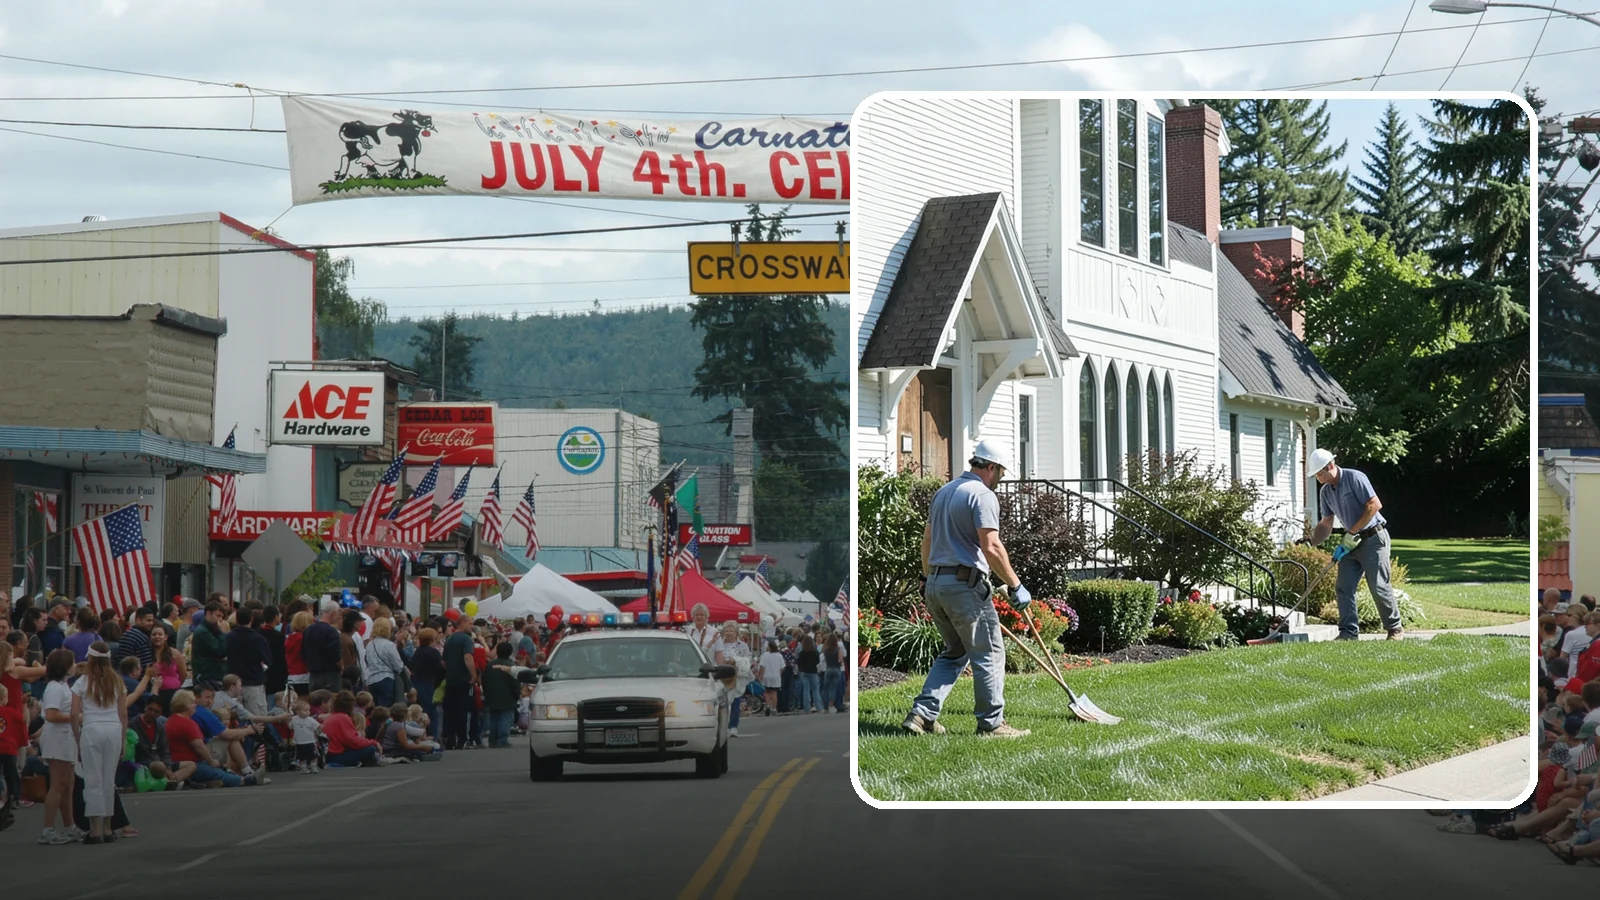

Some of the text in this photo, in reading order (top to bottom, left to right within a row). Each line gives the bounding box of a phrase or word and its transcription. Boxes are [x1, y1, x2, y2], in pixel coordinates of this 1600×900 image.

[695, 121, 850, 150] Carnat
[481, 140, 605, 193] JULY
[632, 149, 746, 197] 4th.
[697, 254, 850, 280] CROSSWA
[283, 380, 373, 420] ACE
[405, 409, 485, 422] CEDAR LOG
[284, 421, 371, 437] Hardware
[416, 428, 477, 447] Coca-Cola
[354, 467, 387, 480] Simpl
[83, 484, 155, 495] St. Vincent de Paul
[688, 526, 741, 535] CRNATION
[699, 535, 730, 543] GLASS
